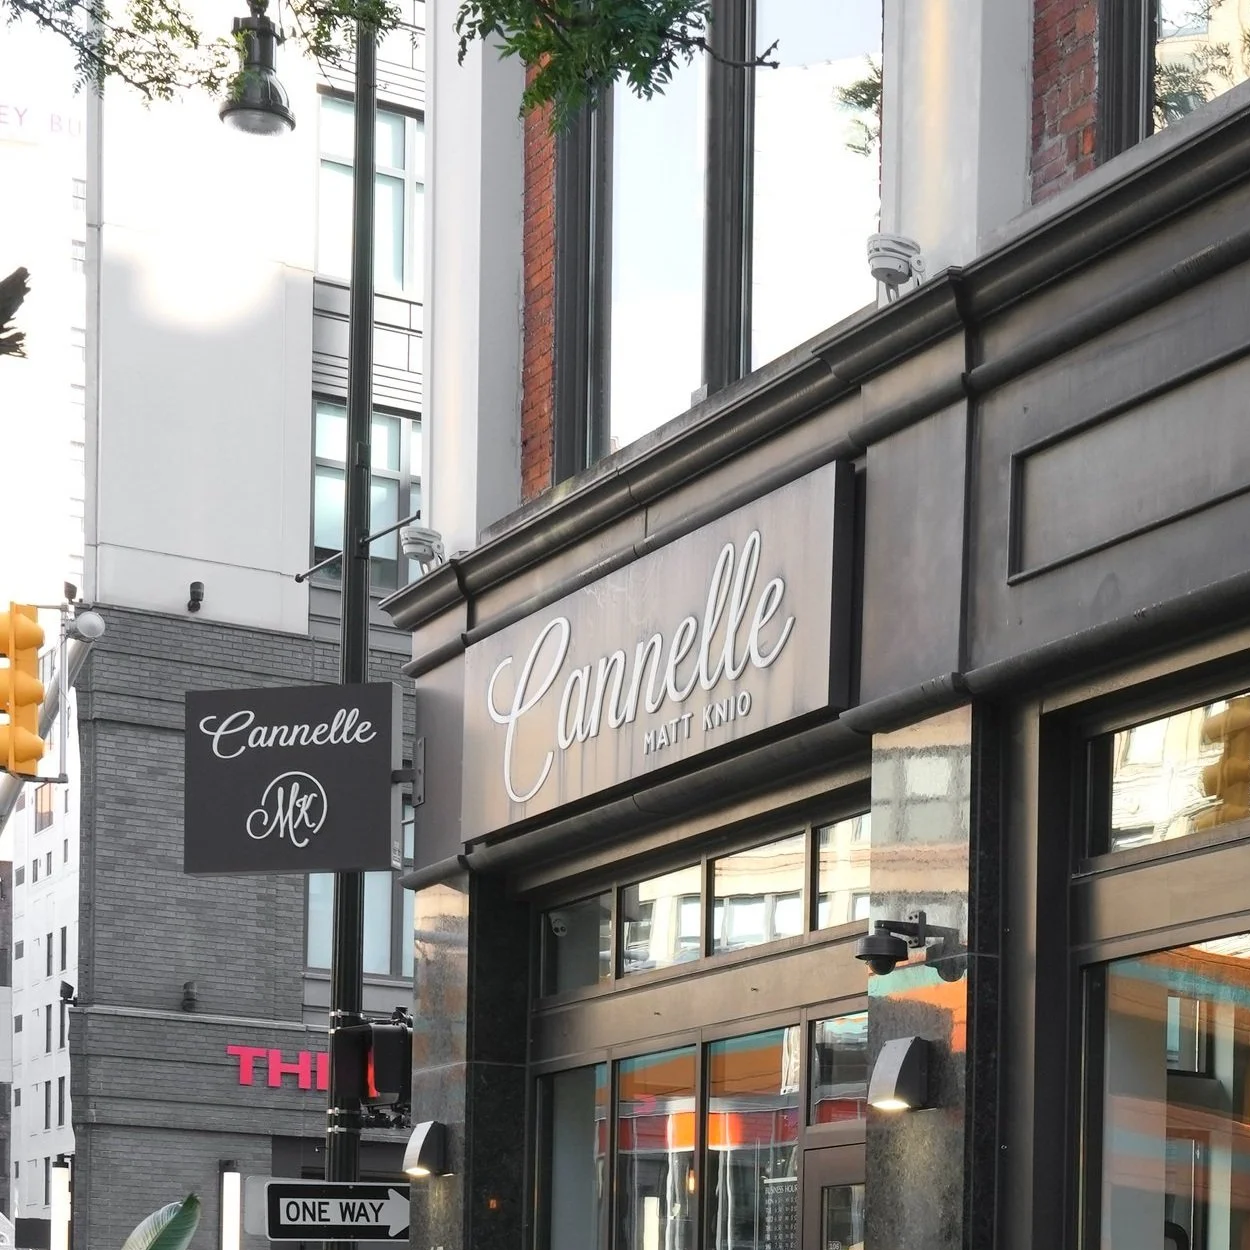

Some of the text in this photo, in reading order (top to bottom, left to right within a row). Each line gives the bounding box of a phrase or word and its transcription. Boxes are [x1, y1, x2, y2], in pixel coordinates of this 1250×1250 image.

[487, 529, 796, 803] Cannelle
[199, 707, 378, 759] Cannelle
[643, 690, 753, 756] MATT KNIO
[285, 1201, 384, 1224] ONE WAY
